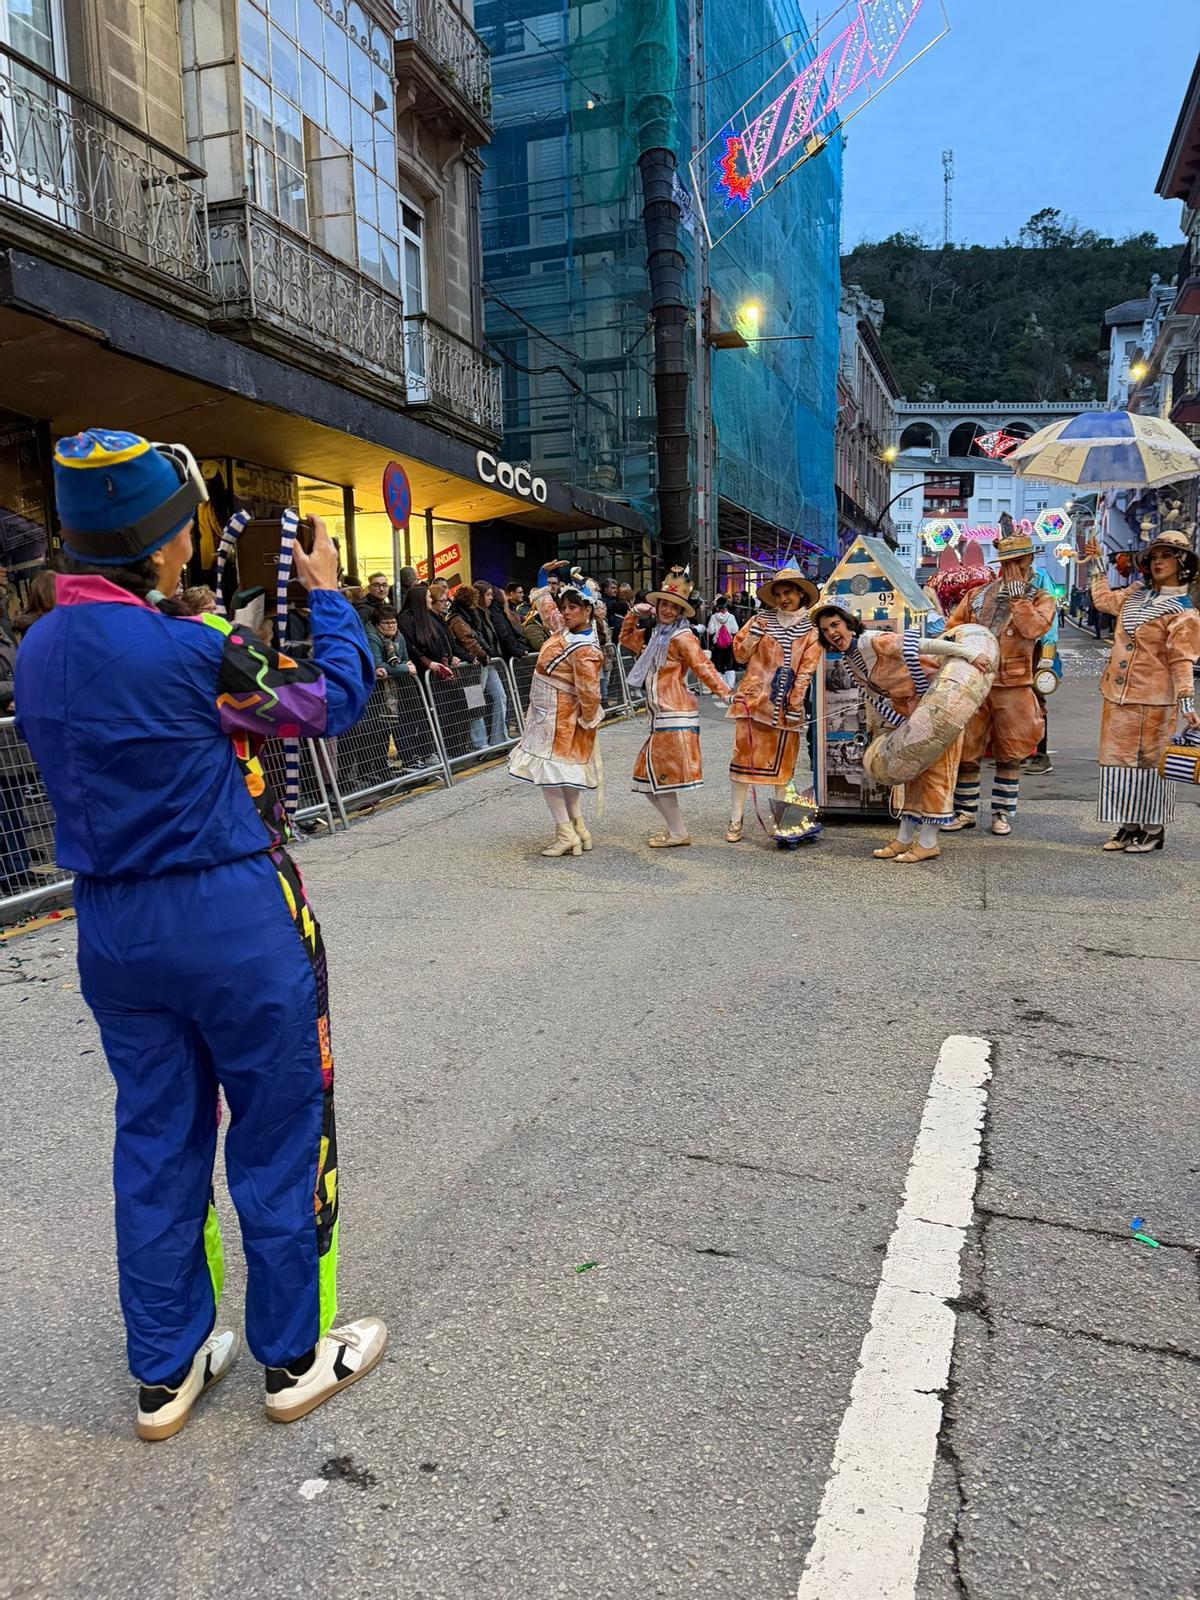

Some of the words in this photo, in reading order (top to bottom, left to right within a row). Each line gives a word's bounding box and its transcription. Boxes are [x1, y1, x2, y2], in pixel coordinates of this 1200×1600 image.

[476, 450, 548, 503] COCO
[418, 548, 458, 577] SEUNDAS
[879, 592, 896, 606] 92
